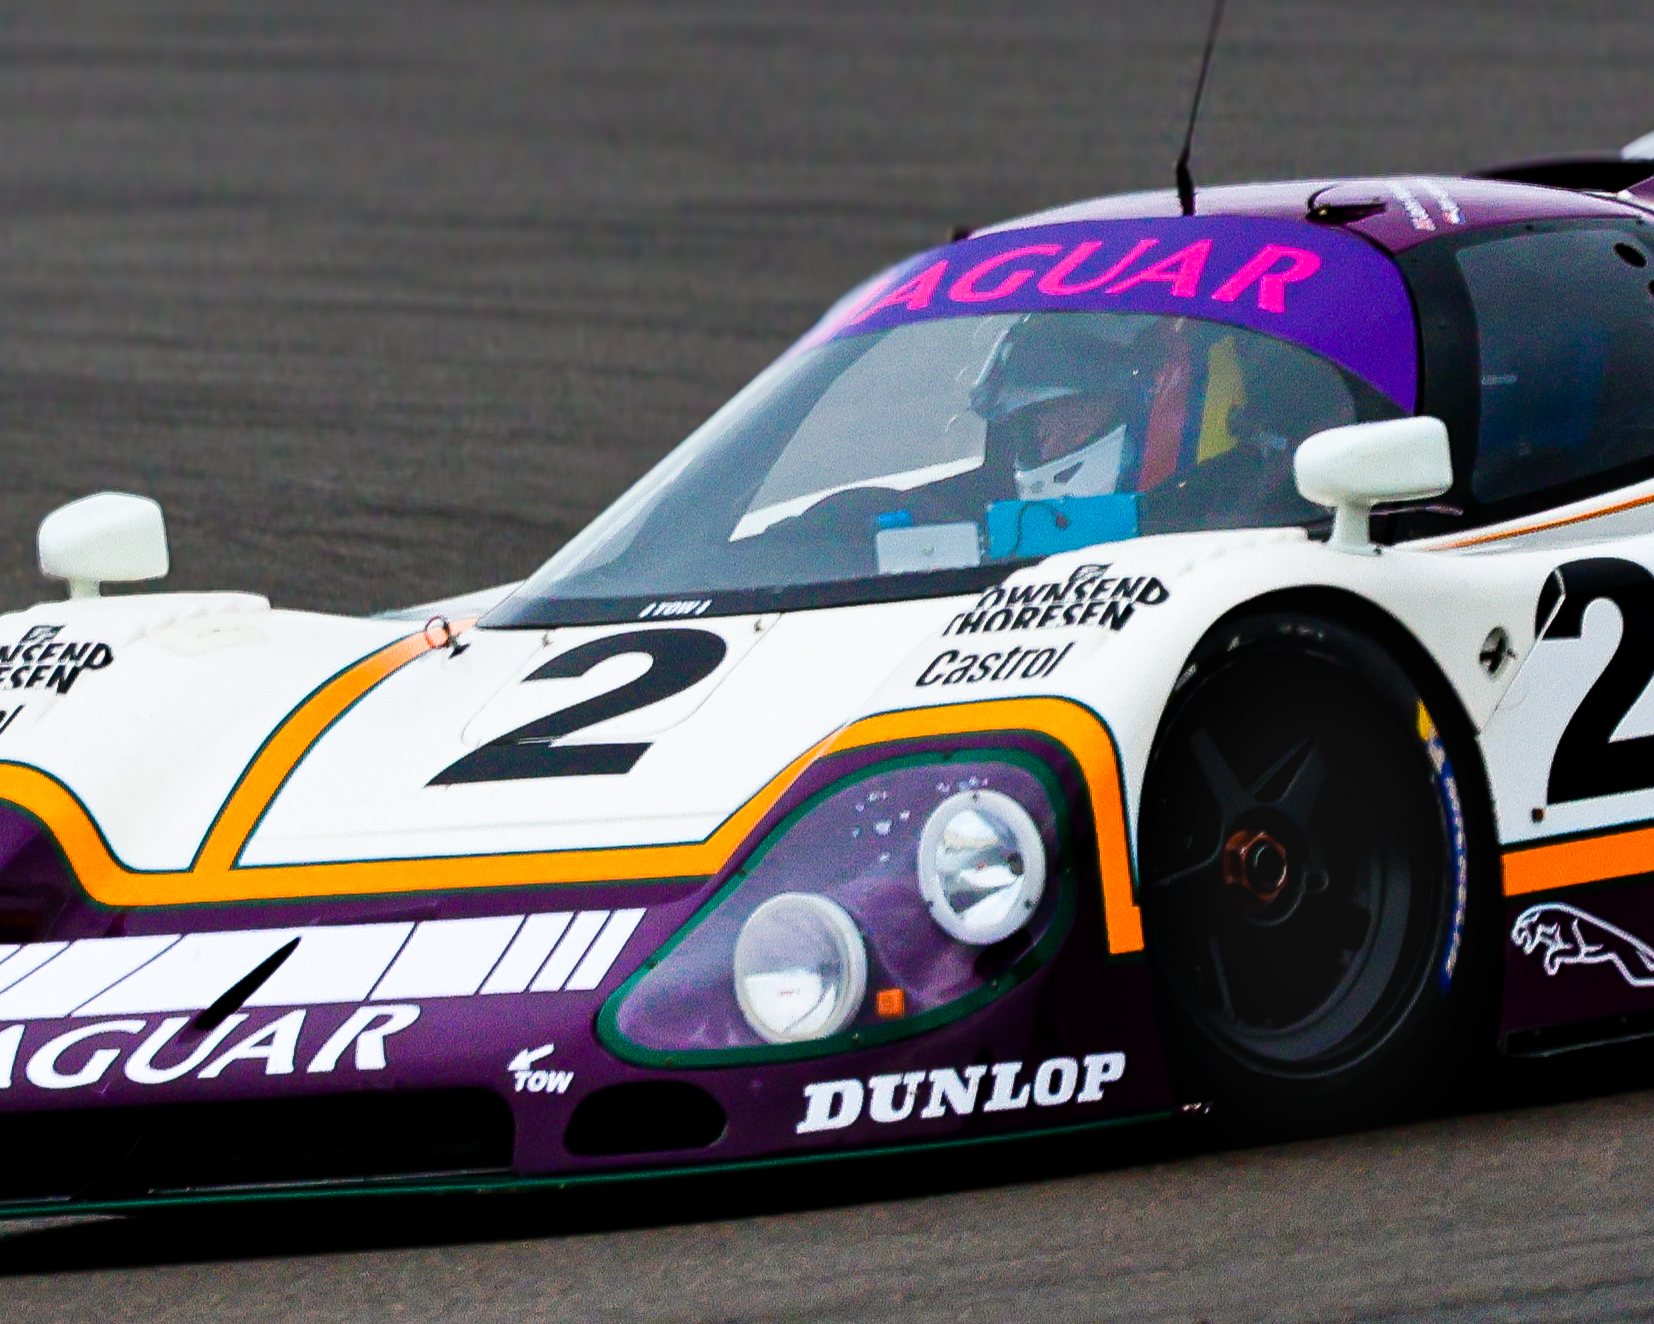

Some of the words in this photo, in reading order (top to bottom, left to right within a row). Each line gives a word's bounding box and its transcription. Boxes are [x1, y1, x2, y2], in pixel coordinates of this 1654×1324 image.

[915, 640, 1076, 687] Castrol
[424, 628, 728, 787] 2
[514, 1069, 574, 1094] TOW
[795, 1051, 1128, 1134] DUNLOP
